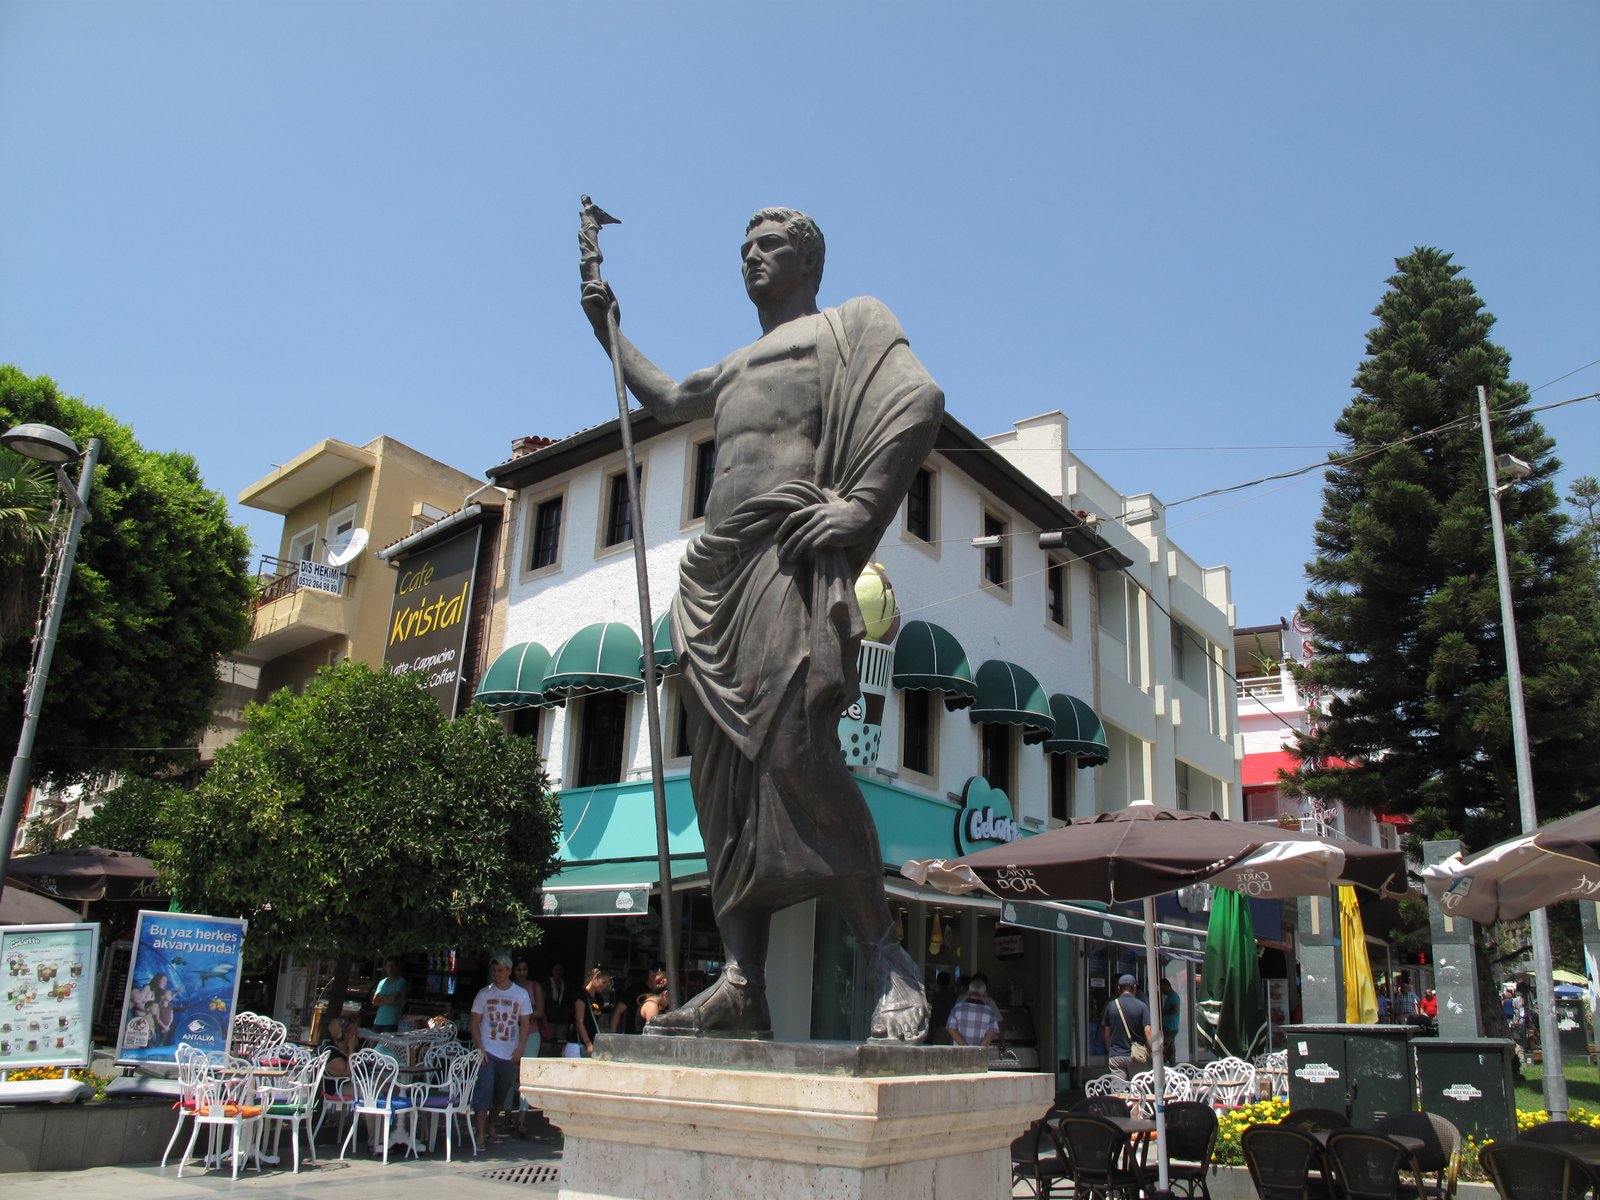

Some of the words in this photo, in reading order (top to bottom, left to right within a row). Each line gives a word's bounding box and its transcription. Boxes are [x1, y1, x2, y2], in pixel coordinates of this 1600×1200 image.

[400, 561, 434, 595] Cafe
[389, 581, 469, 647] Kristal
[430, 667, 456, 687] Coffee
[149, 925, 168, 936] Bu
[170, 928, 193, 939] yaz
[195, 928, 238, 942] herkes
[153, 938, 237, 955] akvaryumda!
[182, 1033, 215, 1042] ANTALYA
